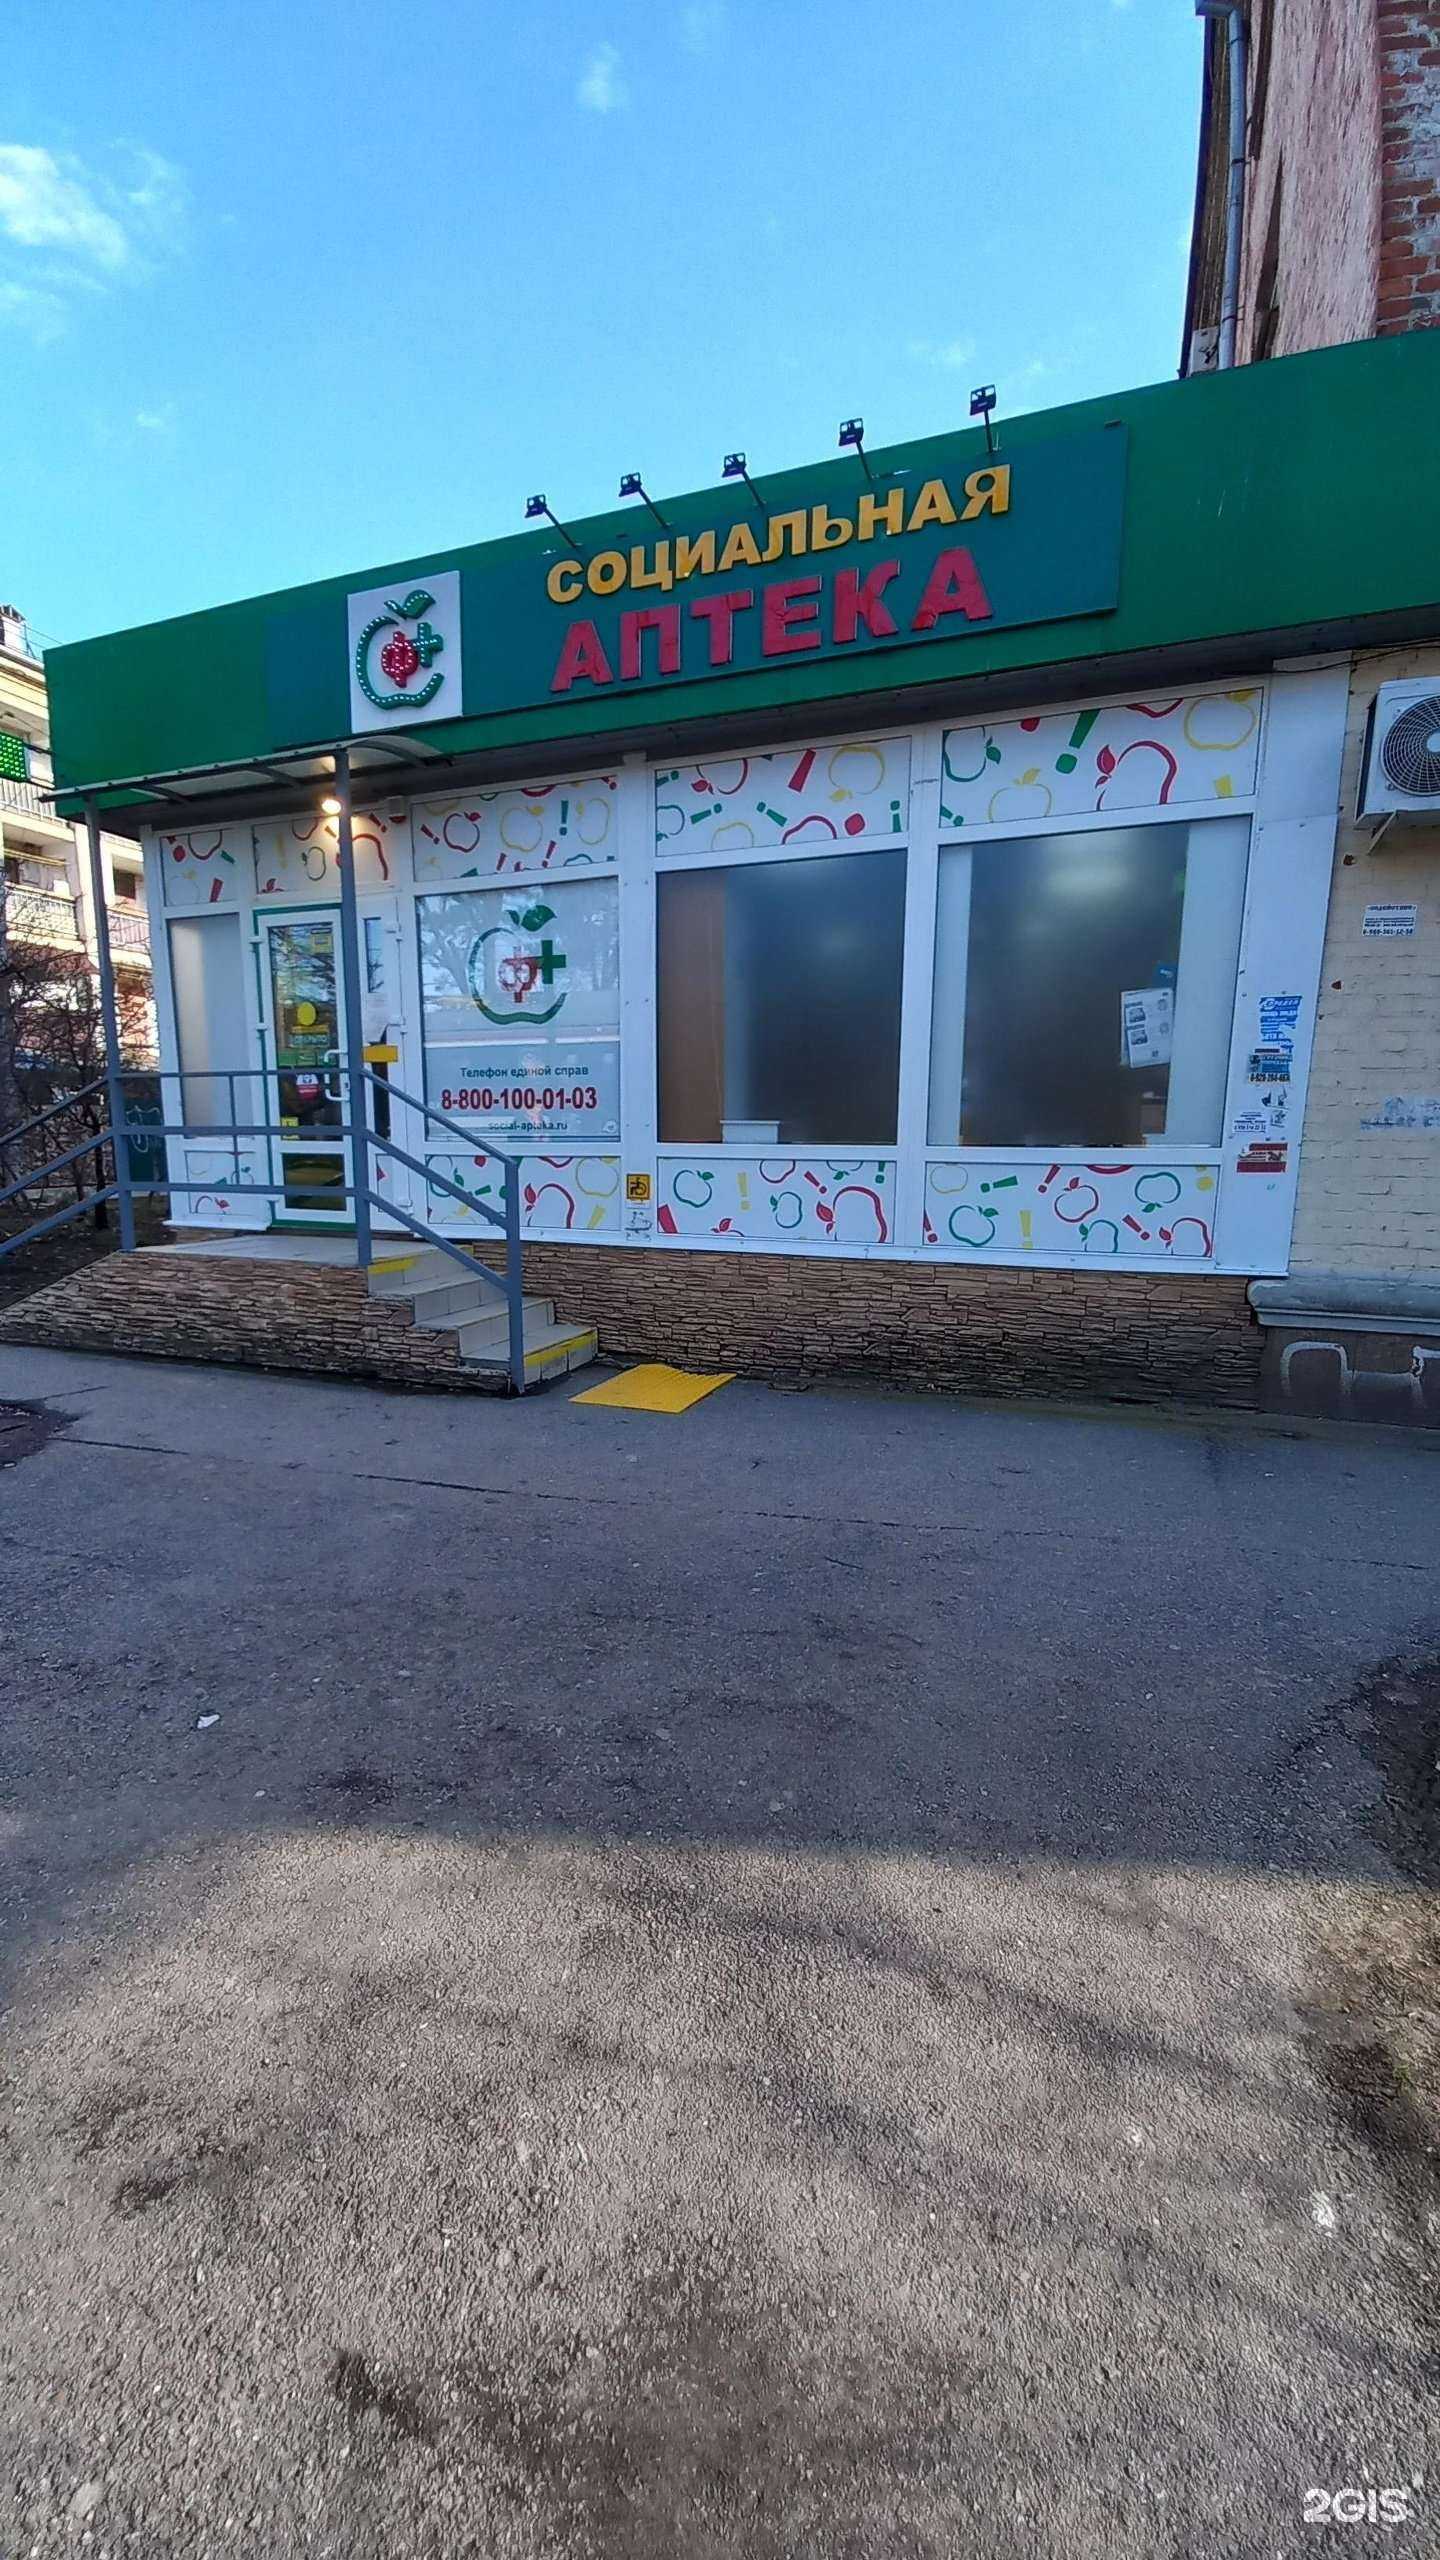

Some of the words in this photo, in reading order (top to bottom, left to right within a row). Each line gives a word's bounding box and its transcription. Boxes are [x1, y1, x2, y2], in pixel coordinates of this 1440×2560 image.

[547, 464, 1011, 604] СОЦИАЛЬНАЯ
[551, 548, 994, 692] АПТЕКА
[441, 1086, 598, 1110] 8-800-100-01-03
[460, 1066, 508, 1079] Телефон
[555, 1066, 589, 1079] справ
